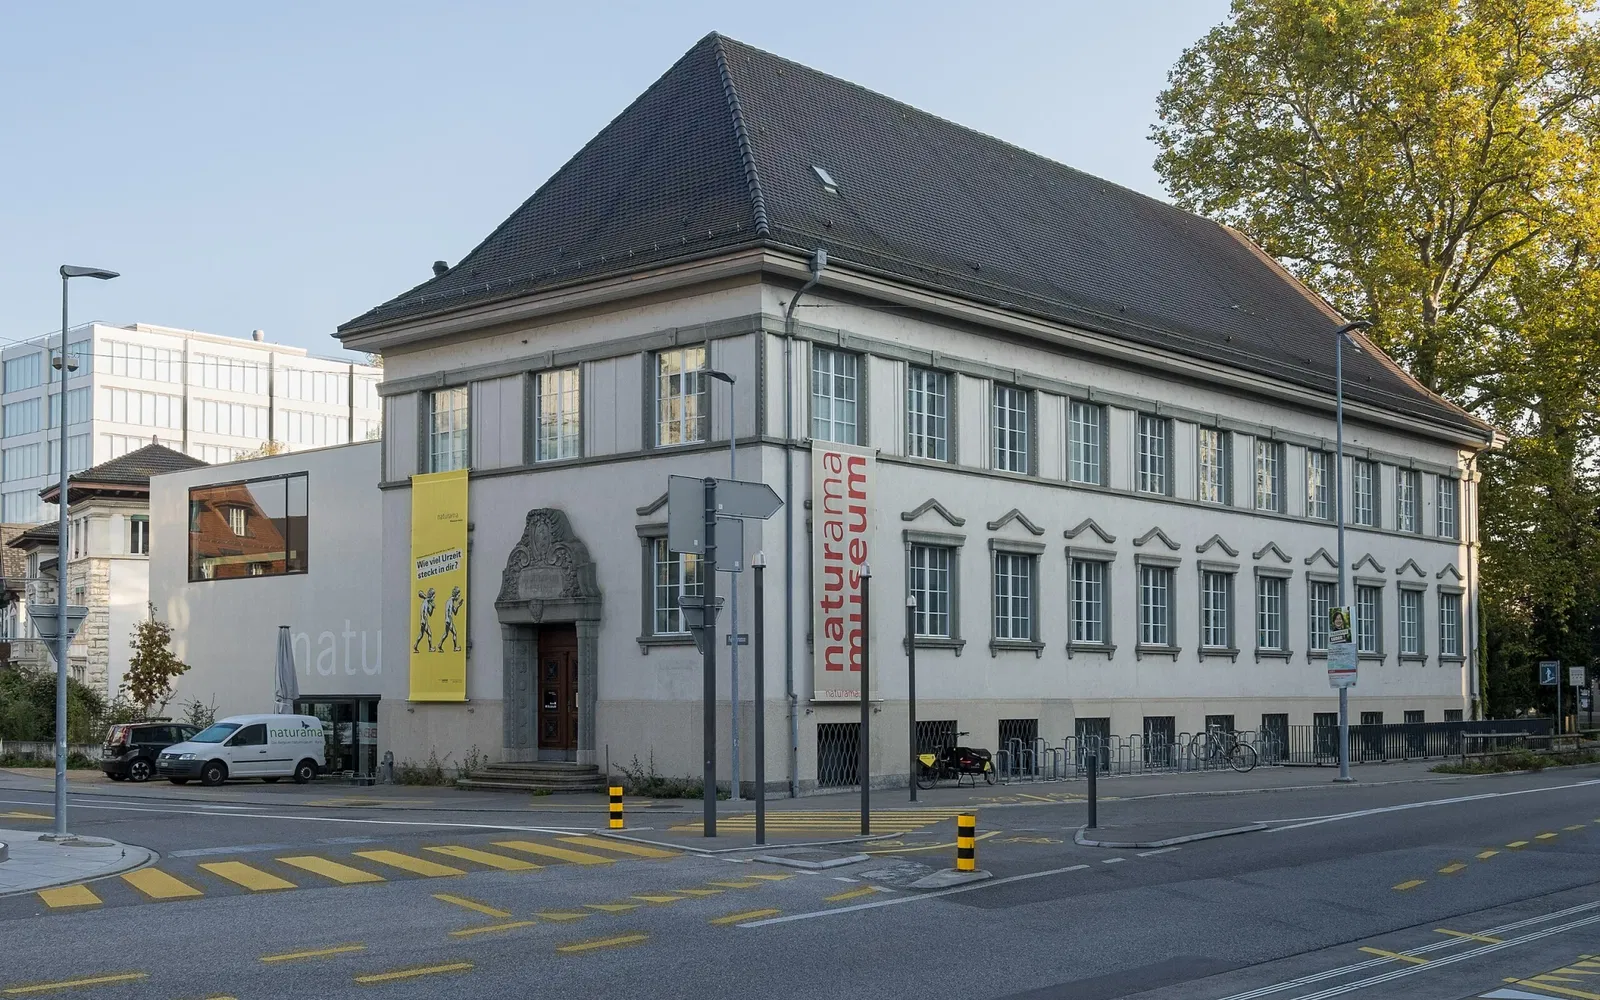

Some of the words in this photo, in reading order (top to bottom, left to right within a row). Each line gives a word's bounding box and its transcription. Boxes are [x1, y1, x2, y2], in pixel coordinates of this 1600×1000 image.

[416, 560, 428, 568] Wie
[430, 556, 440, 565] viel
[442, 551, 462, 562] Urzeit
[418, 568, 438, 579] steckt
[438, 566, 444, 574] in
[446, 562, 458, 570] dir?
[820, 452, 844, 672] naturama
[847, 456, 868, 672] museum
[291, 619, 382, 676] natu
[270, 728, 323, 738] naturama
